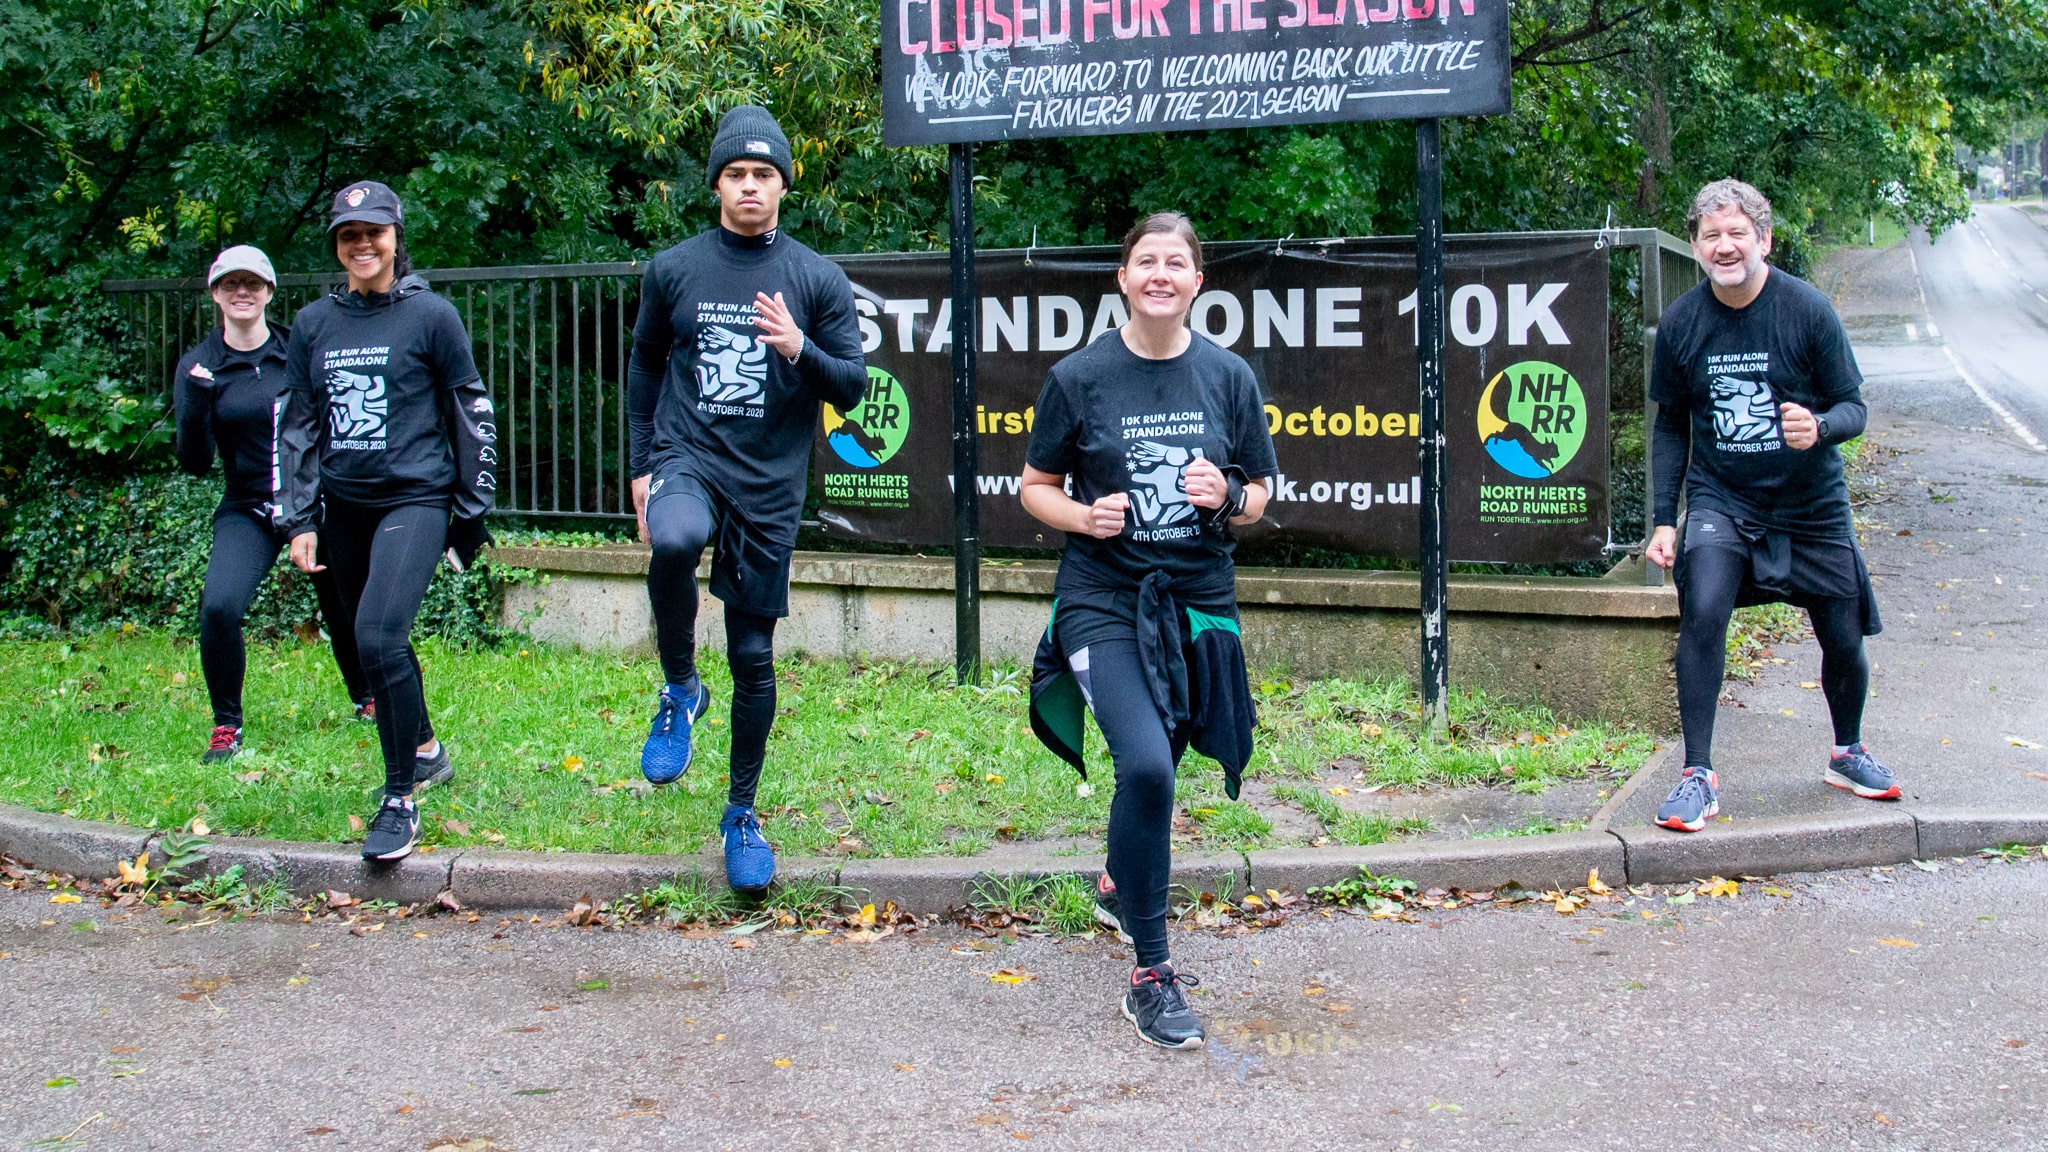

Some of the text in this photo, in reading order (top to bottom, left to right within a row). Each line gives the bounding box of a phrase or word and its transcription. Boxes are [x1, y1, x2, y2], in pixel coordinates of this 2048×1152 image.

[900, 0, 1071, 54] CLOSED
[905, 40, 1485, 103] WE LOOK FORWARD TO WELCOMING BACK OUR LITTLE
[1012, 93, 1133, 129] FARMERS
[1135, 93, 1162, 124] IN
[1161, 90, 1209, 122] THE
[697, 302, 761, 314] 10K RUN ALO
[325, 346, 390, 360] 10K RUN ALONE
[1707, 352, 1769, 364] 10K RUN ALONE
[324, 356, 389, 370] STANDALONE
[1707, 362, 1769, 375] STANDALONE
[1517, 373, 1570, 403] NH
[708, 403, 745, 416] OCTOBER
[745, 407, 765, 418] 2020
[862, 403, 900, 429] RR
[1121, 411, 1204, 426] 10K RUN ALONE
[1530, 404, 1576, 434] RR
[1122, 423, 1205, 440] STANDALONE
[1727, 443, 1763, 453] OCTOBER
[1763, 440, 1780, 451] 2020
[824, 473, 909, 488] NORTH HERTS
[825, 487, 909, 500] ROAD RUNNERS
[1480, 485, 1587, 501] NORTH HERTS
[1480, 500, 1588, 514] ROAD RUNNERS
[1480, 515, 1495, 523] RUN
[1132, 530, 1150, 542] 4TH
[1151, 526, 1194, 541] OCTOBER
